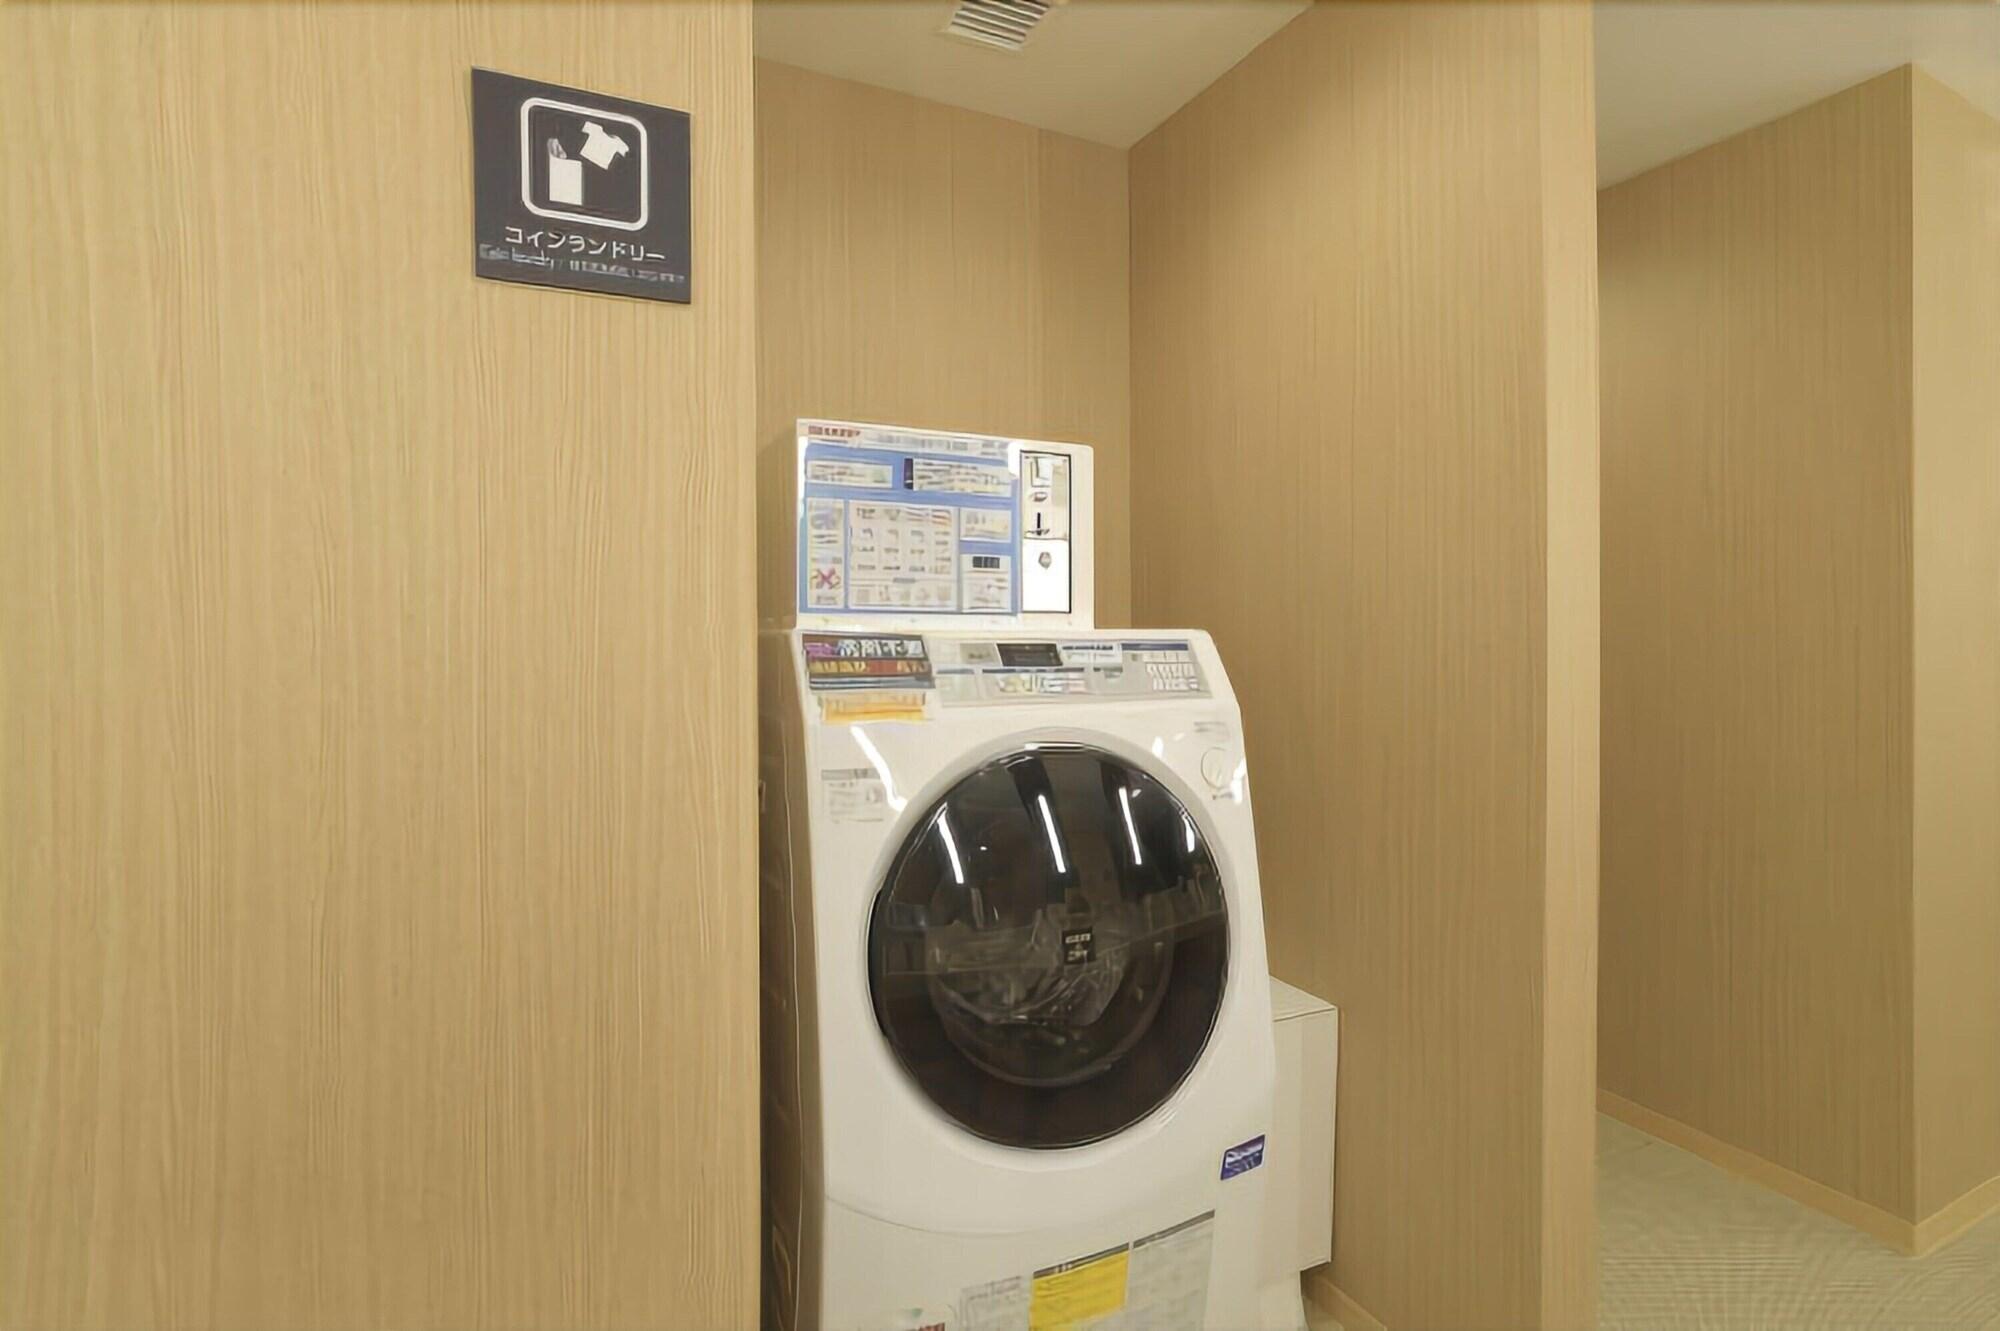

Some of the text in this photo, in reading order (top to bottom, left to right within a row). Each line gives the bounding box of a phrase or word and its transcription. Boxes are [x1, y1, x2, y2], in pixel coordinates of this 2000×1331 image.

[505, 226, 665, 261] コインランドリー
